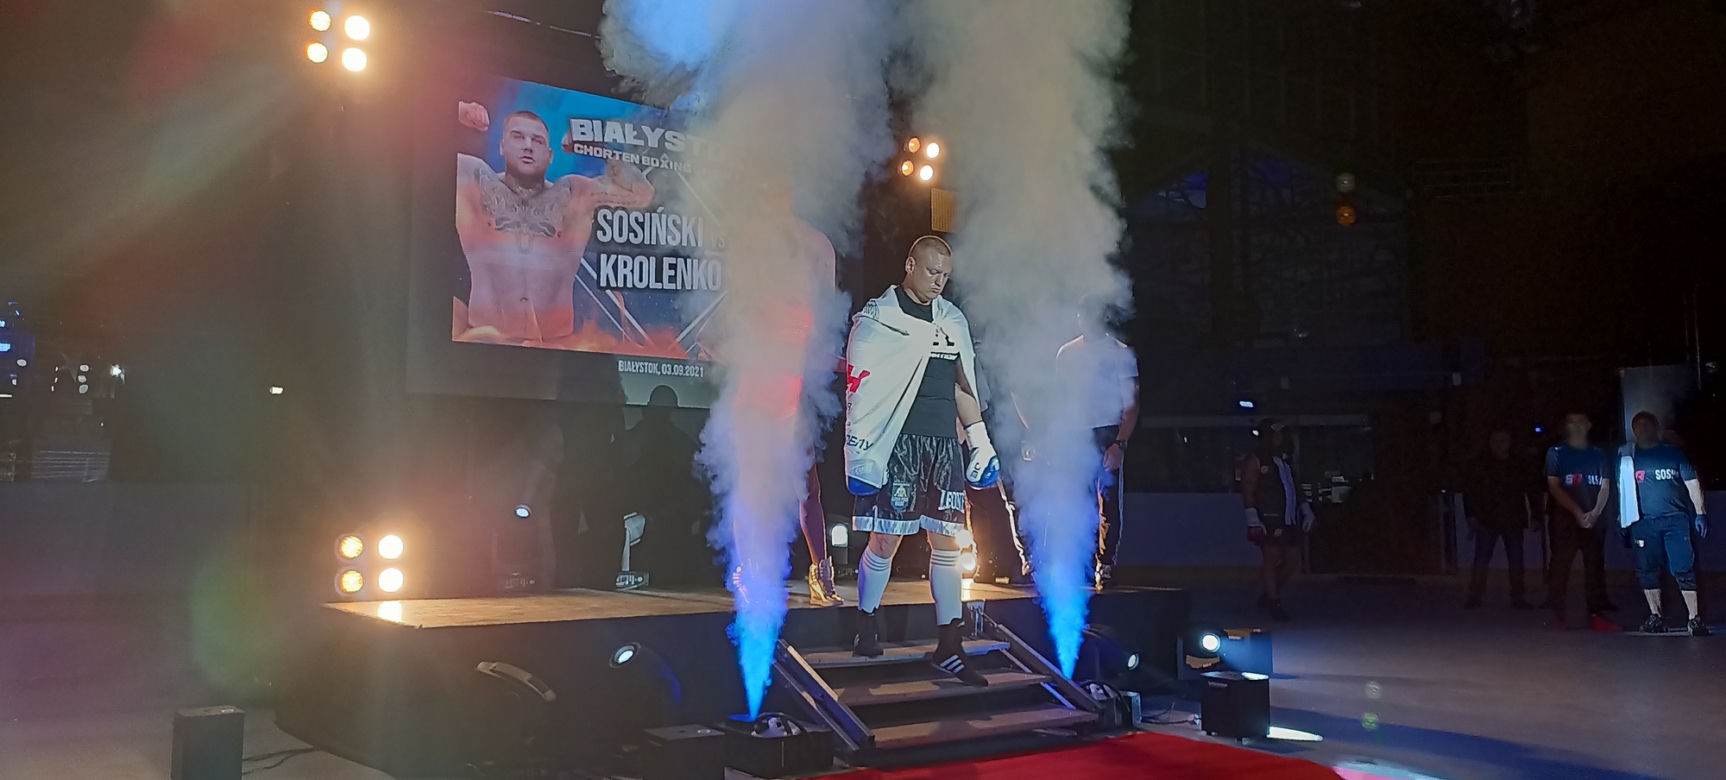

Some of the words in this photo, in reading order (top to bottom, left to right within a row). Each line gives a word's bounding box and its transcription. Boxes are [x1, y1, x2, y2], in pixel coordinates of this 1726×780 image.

[573, 143, 640, 165] CHORTEN
[596, 206, 704, 248] SOSIŃSKI
[599, 253, 721, 291] KROLENKO
[618, 360, 660, 376] BIAŁYSTOK,
[661, 363, 704, 378] 03.09.2021
